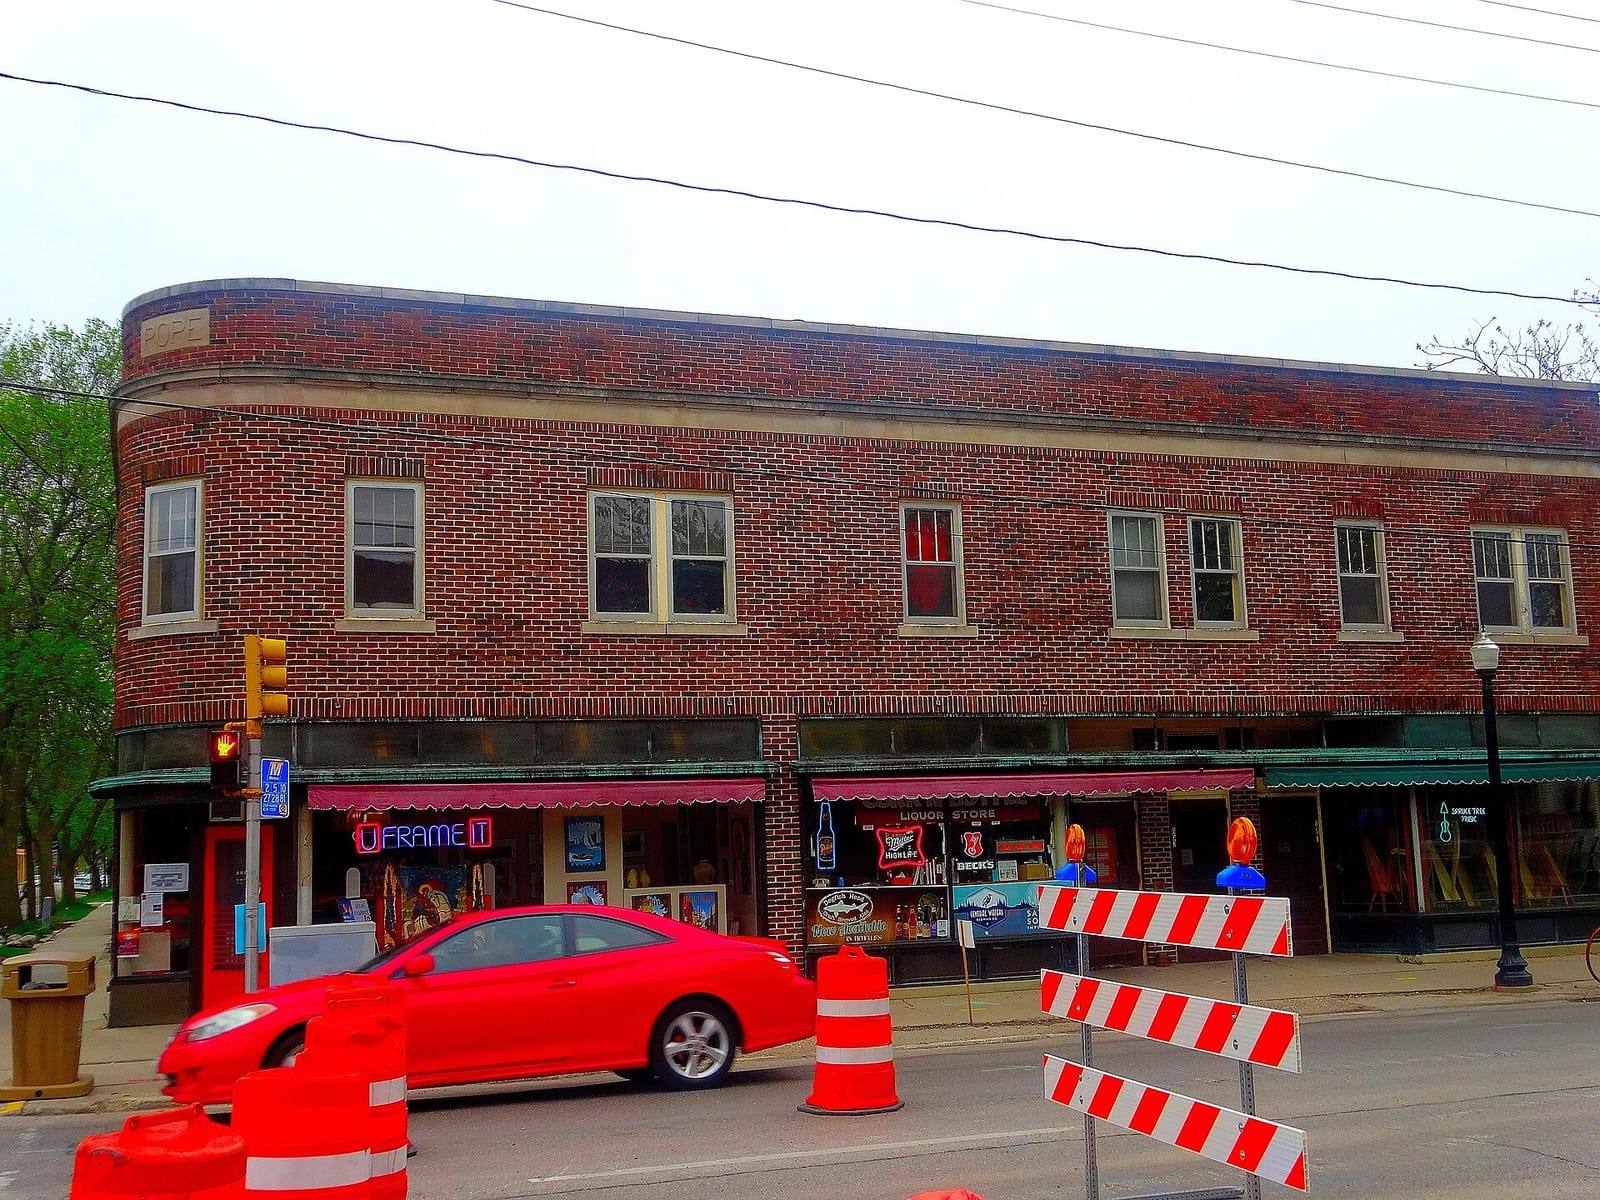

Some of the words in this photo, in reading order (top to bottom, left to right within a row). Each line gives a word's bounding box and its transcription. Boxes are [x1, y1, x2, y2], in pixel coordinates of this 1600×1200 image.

[144, 317, 202, 351] POPE
[265, 784, 270, 793] 2
[273, 784, 278, 793] 5
[263, 794, 271, 803] 27
[271, 794, 280, 803] 28
[900, 811, 944, 821] LIQUOR
[952, 809, 996, 820] STORE
[1451, 807, 1471, 815] SPRUCE
[1471, 807, 1486, 815] TREE
[360, 827, 377, 851] U
[382, 823, 466, 849] FRAME
[471, 821, 488, 845] IT
[885, 834, 914, 851] Miller
[885, 851, 902, 860] HIGH
[902, 850, 918, 859] LIFE
[957, 860, 995, 871] BECK'S
[812, 924, 837, 938] Now
[838, 920, 887, 937] Available
[854, 934, 883, 942] BOTTLES
